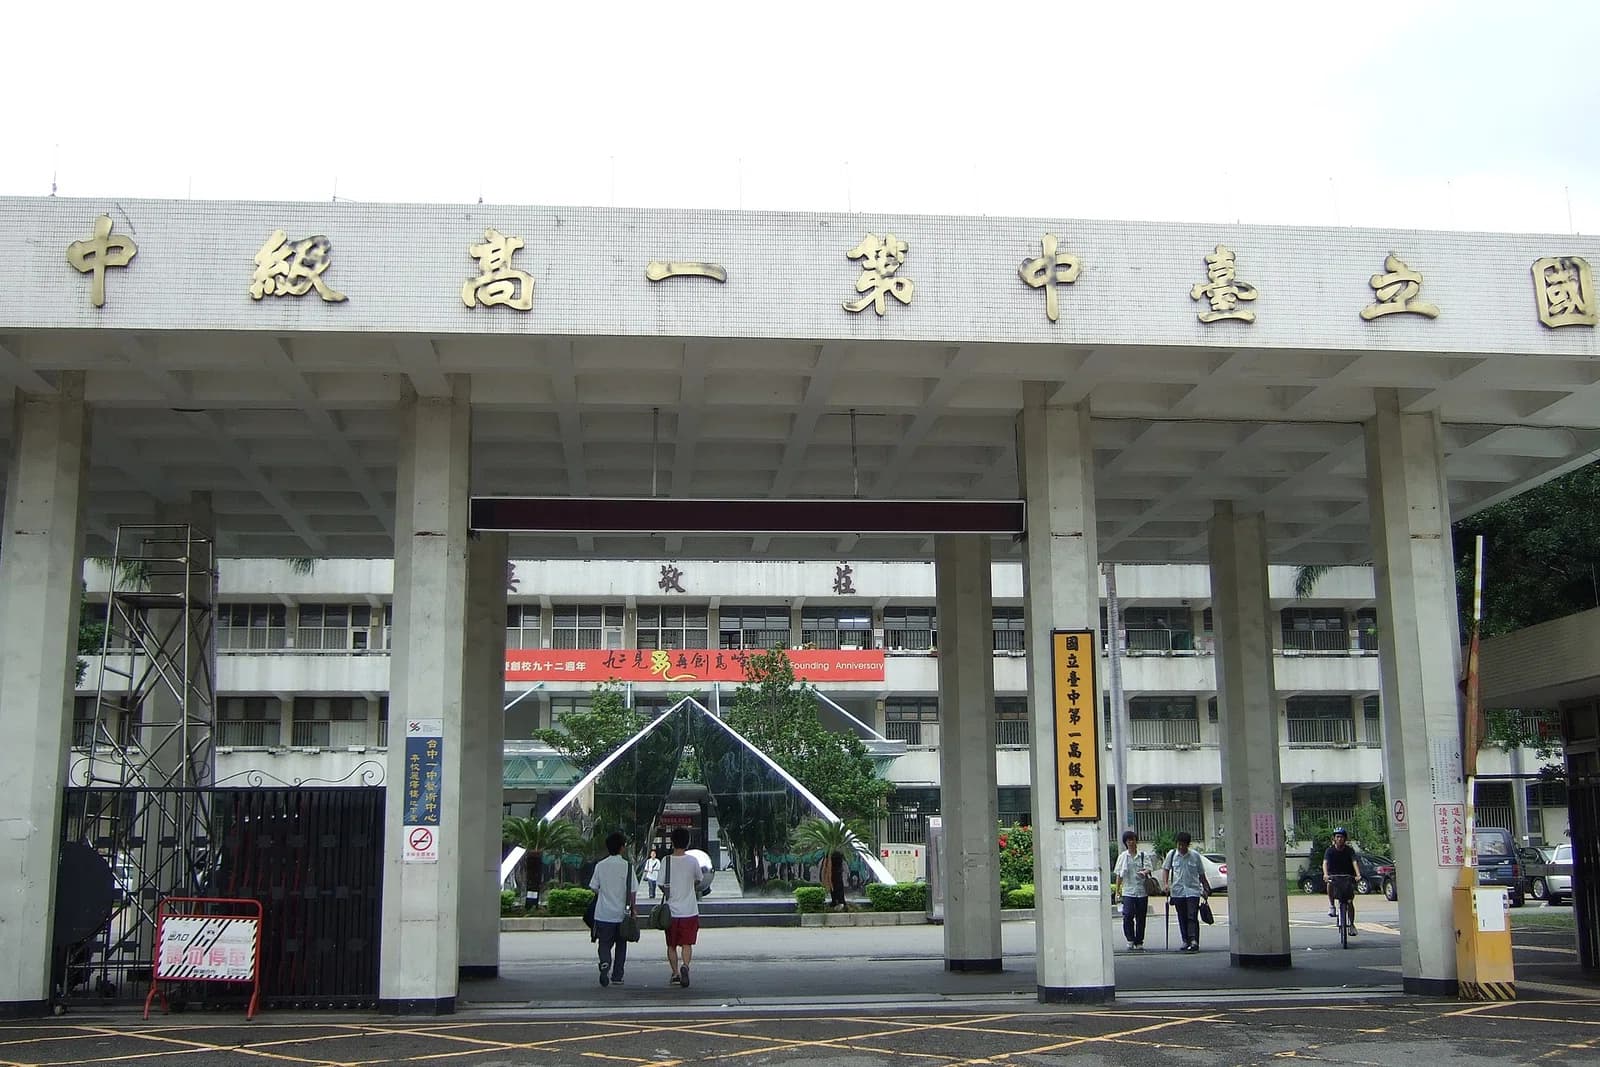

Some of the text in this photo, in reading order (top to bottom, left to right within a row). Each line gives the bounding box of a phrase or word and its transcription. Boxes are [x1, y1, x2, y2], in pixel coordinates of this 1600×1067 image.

[836, 661, 884, 670] Anniversary
[1066, 636, 1085, 815] 國立臺中第一高級中學
